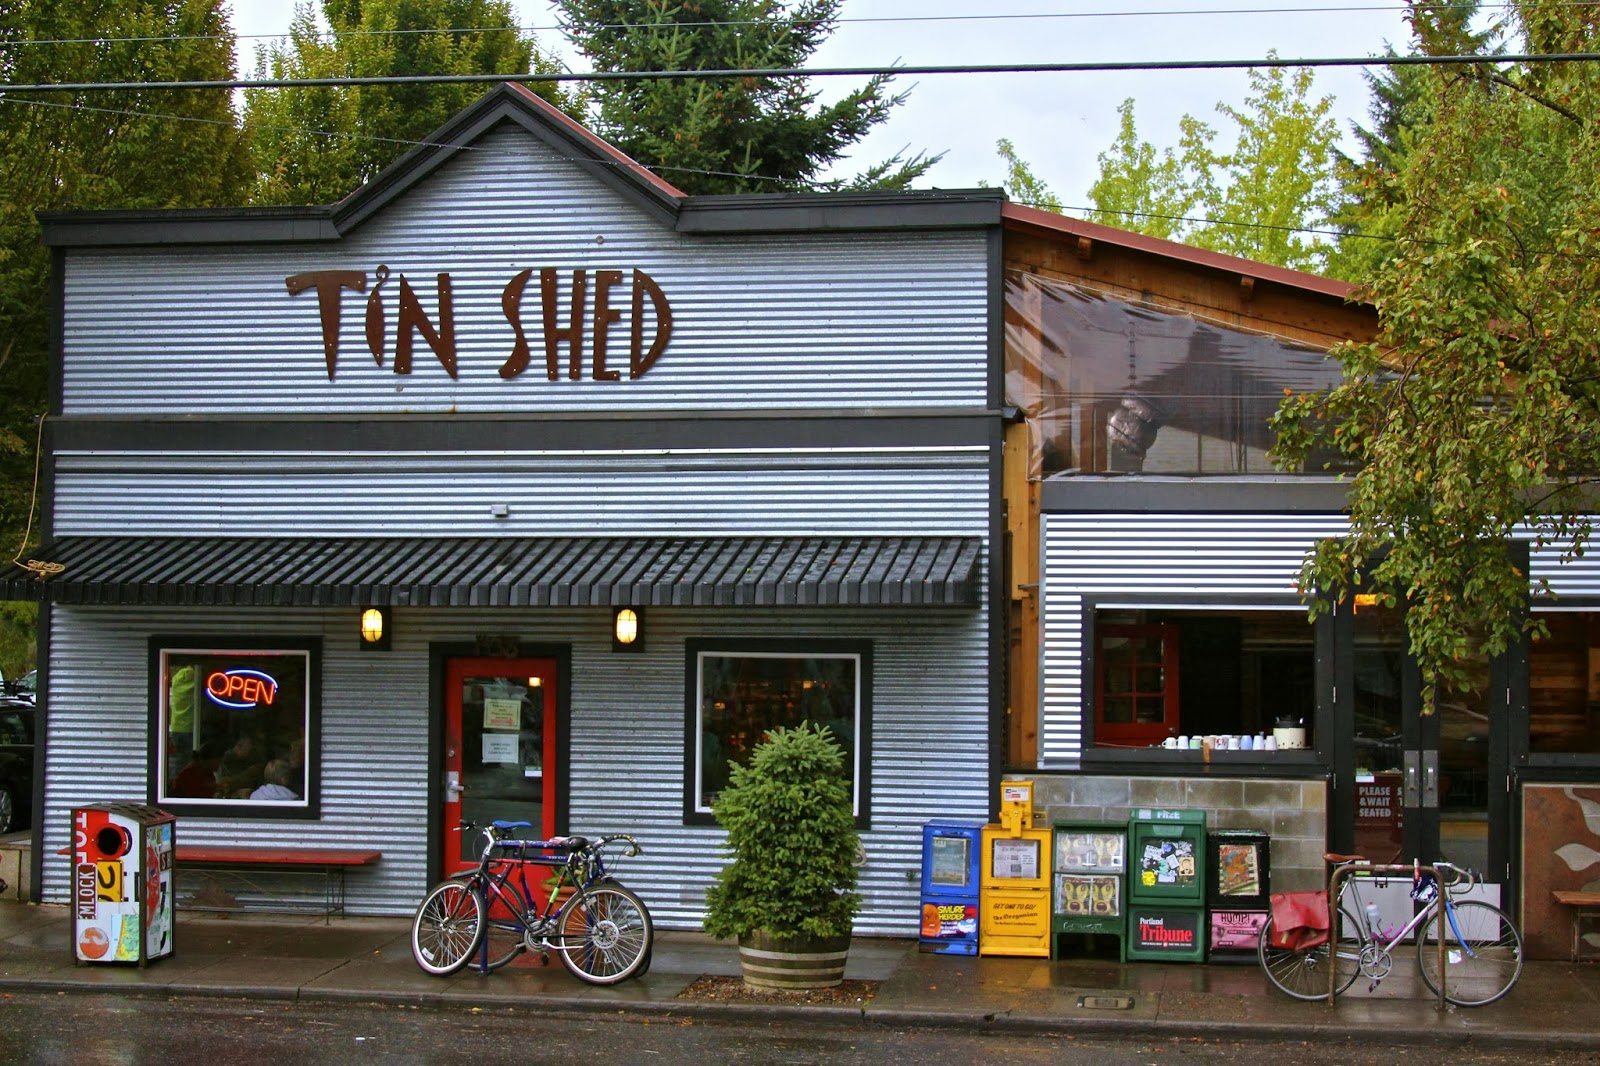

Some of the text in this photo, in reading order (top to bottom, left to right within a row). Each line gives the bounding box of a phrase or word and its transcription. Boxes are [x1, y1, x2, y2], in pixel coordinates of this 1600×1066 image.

[498, 266, 672, 381] SHED
[207, 672, 275, 705] OPEN
[1359, 786, 1391, 796] PLEASE
[1359, 807, 1392, 818] SEATED
[937, 905, 966, 914] SMURF
[938, 913, 965, 921] HERDER
[1139, 917, 1164, 925] Portland
[1139, 924, 1193, 942] Tribune
